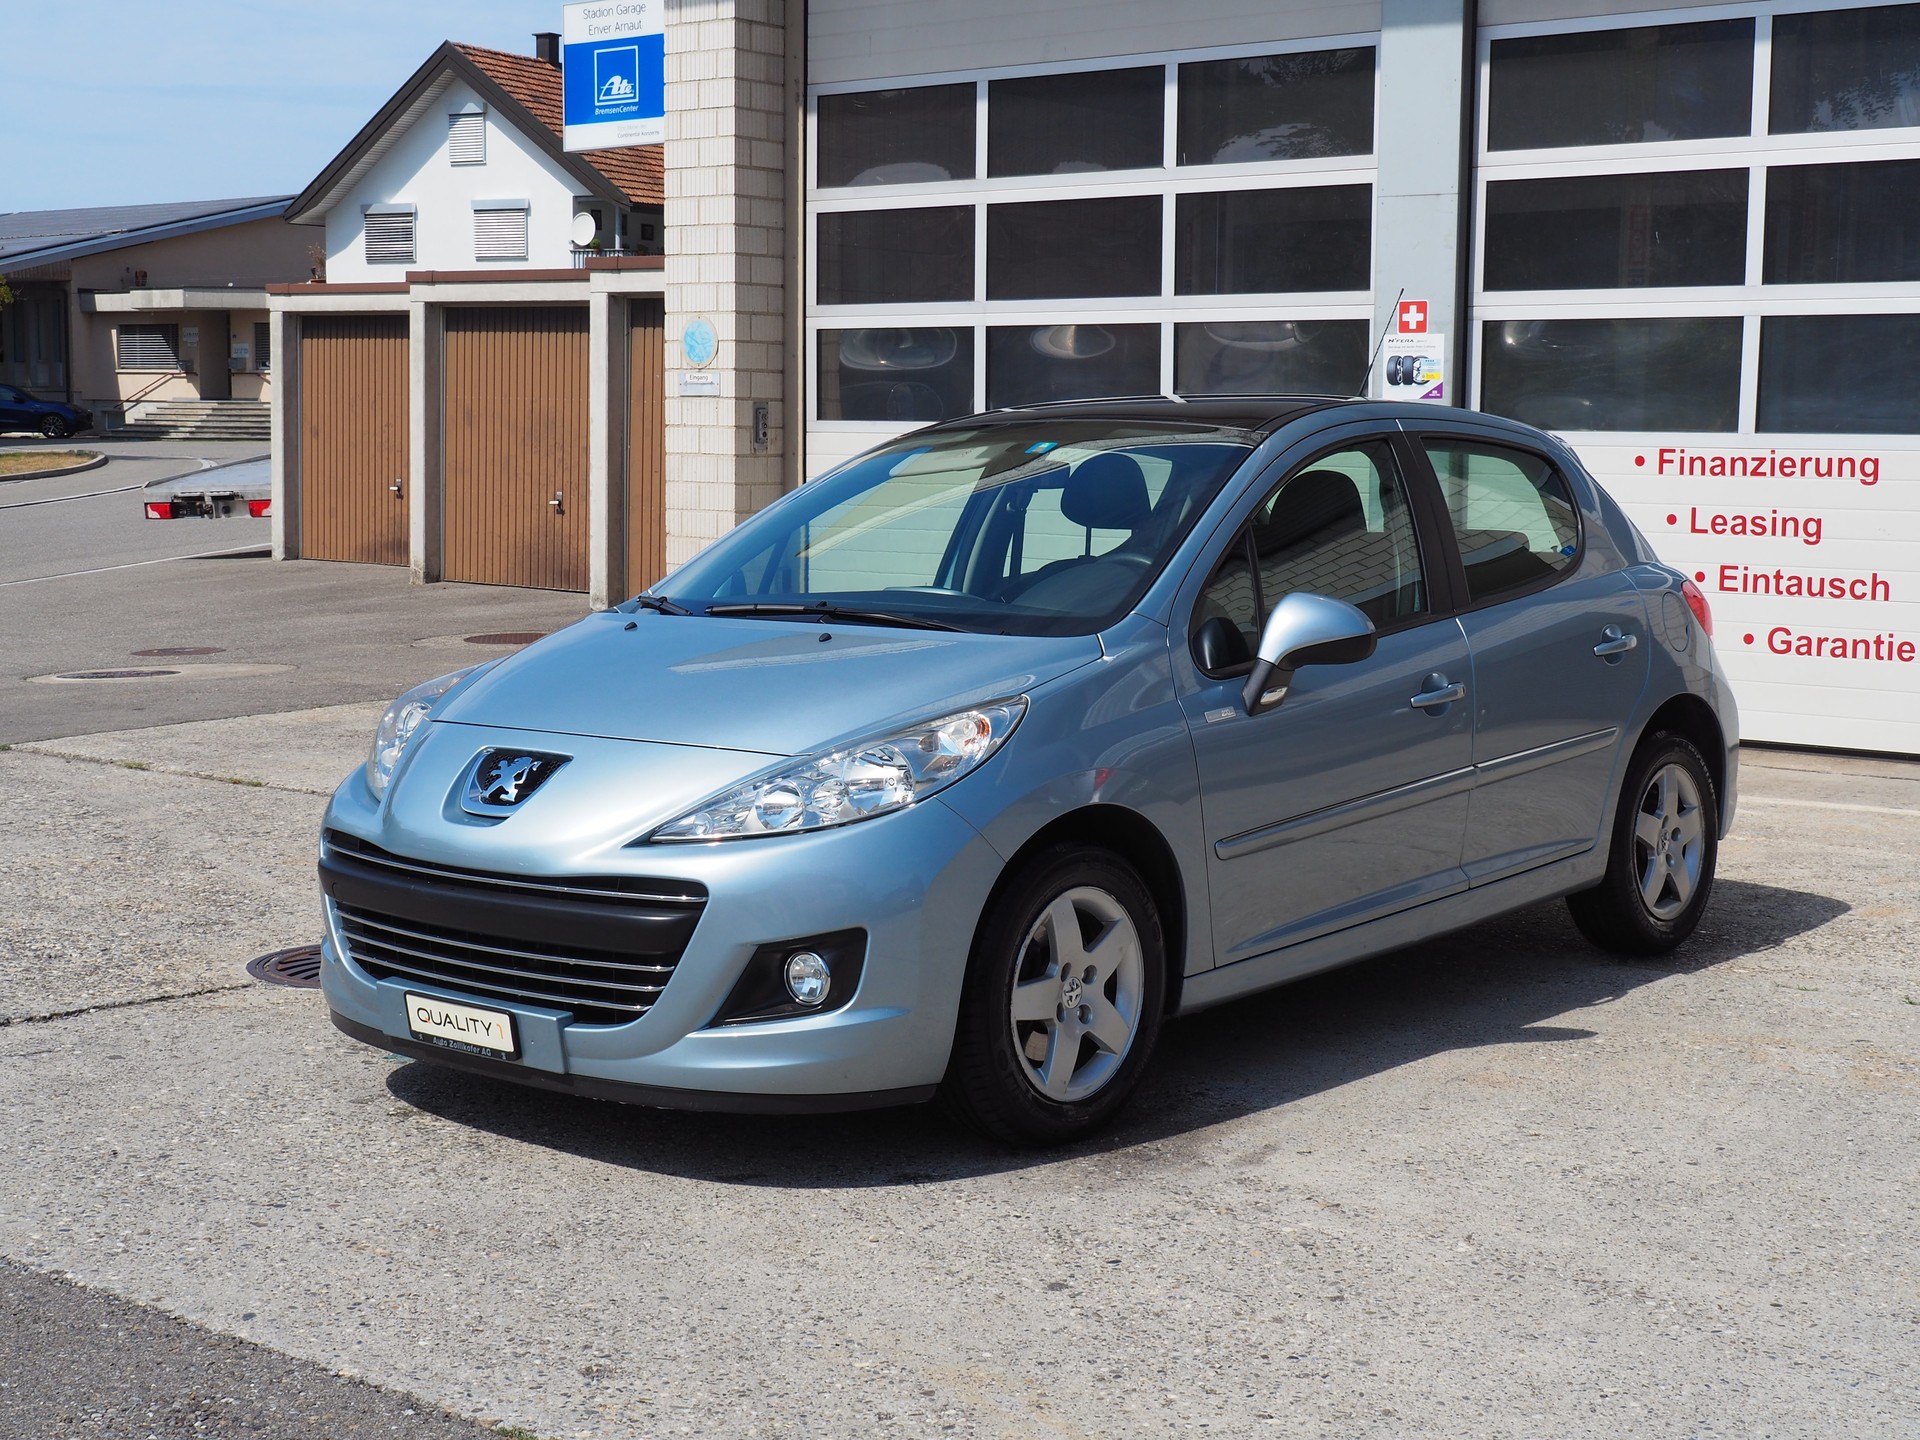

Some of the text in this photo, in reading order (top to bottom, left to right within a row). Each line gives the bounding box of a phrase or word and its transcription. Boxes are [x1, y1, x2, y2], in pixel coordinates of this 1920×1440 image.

[583, 3, 646, 20] Stadion Garage
[588, 20, 642, 36] Enver Arnaut
[594, 105, 639, 116] BremsenCenter
[1658, 448, 1880, 486] Finanzierung
[1690, 507, 1823, 546] Leasing
[1718, 565, 1891, 602] Eintausch
[1767, 627, 1916, 663] Garantie
[416, 1007, 493, 1037] QUALITY
[433, 1036, 492, 1056] Auto Zollikofer AG
